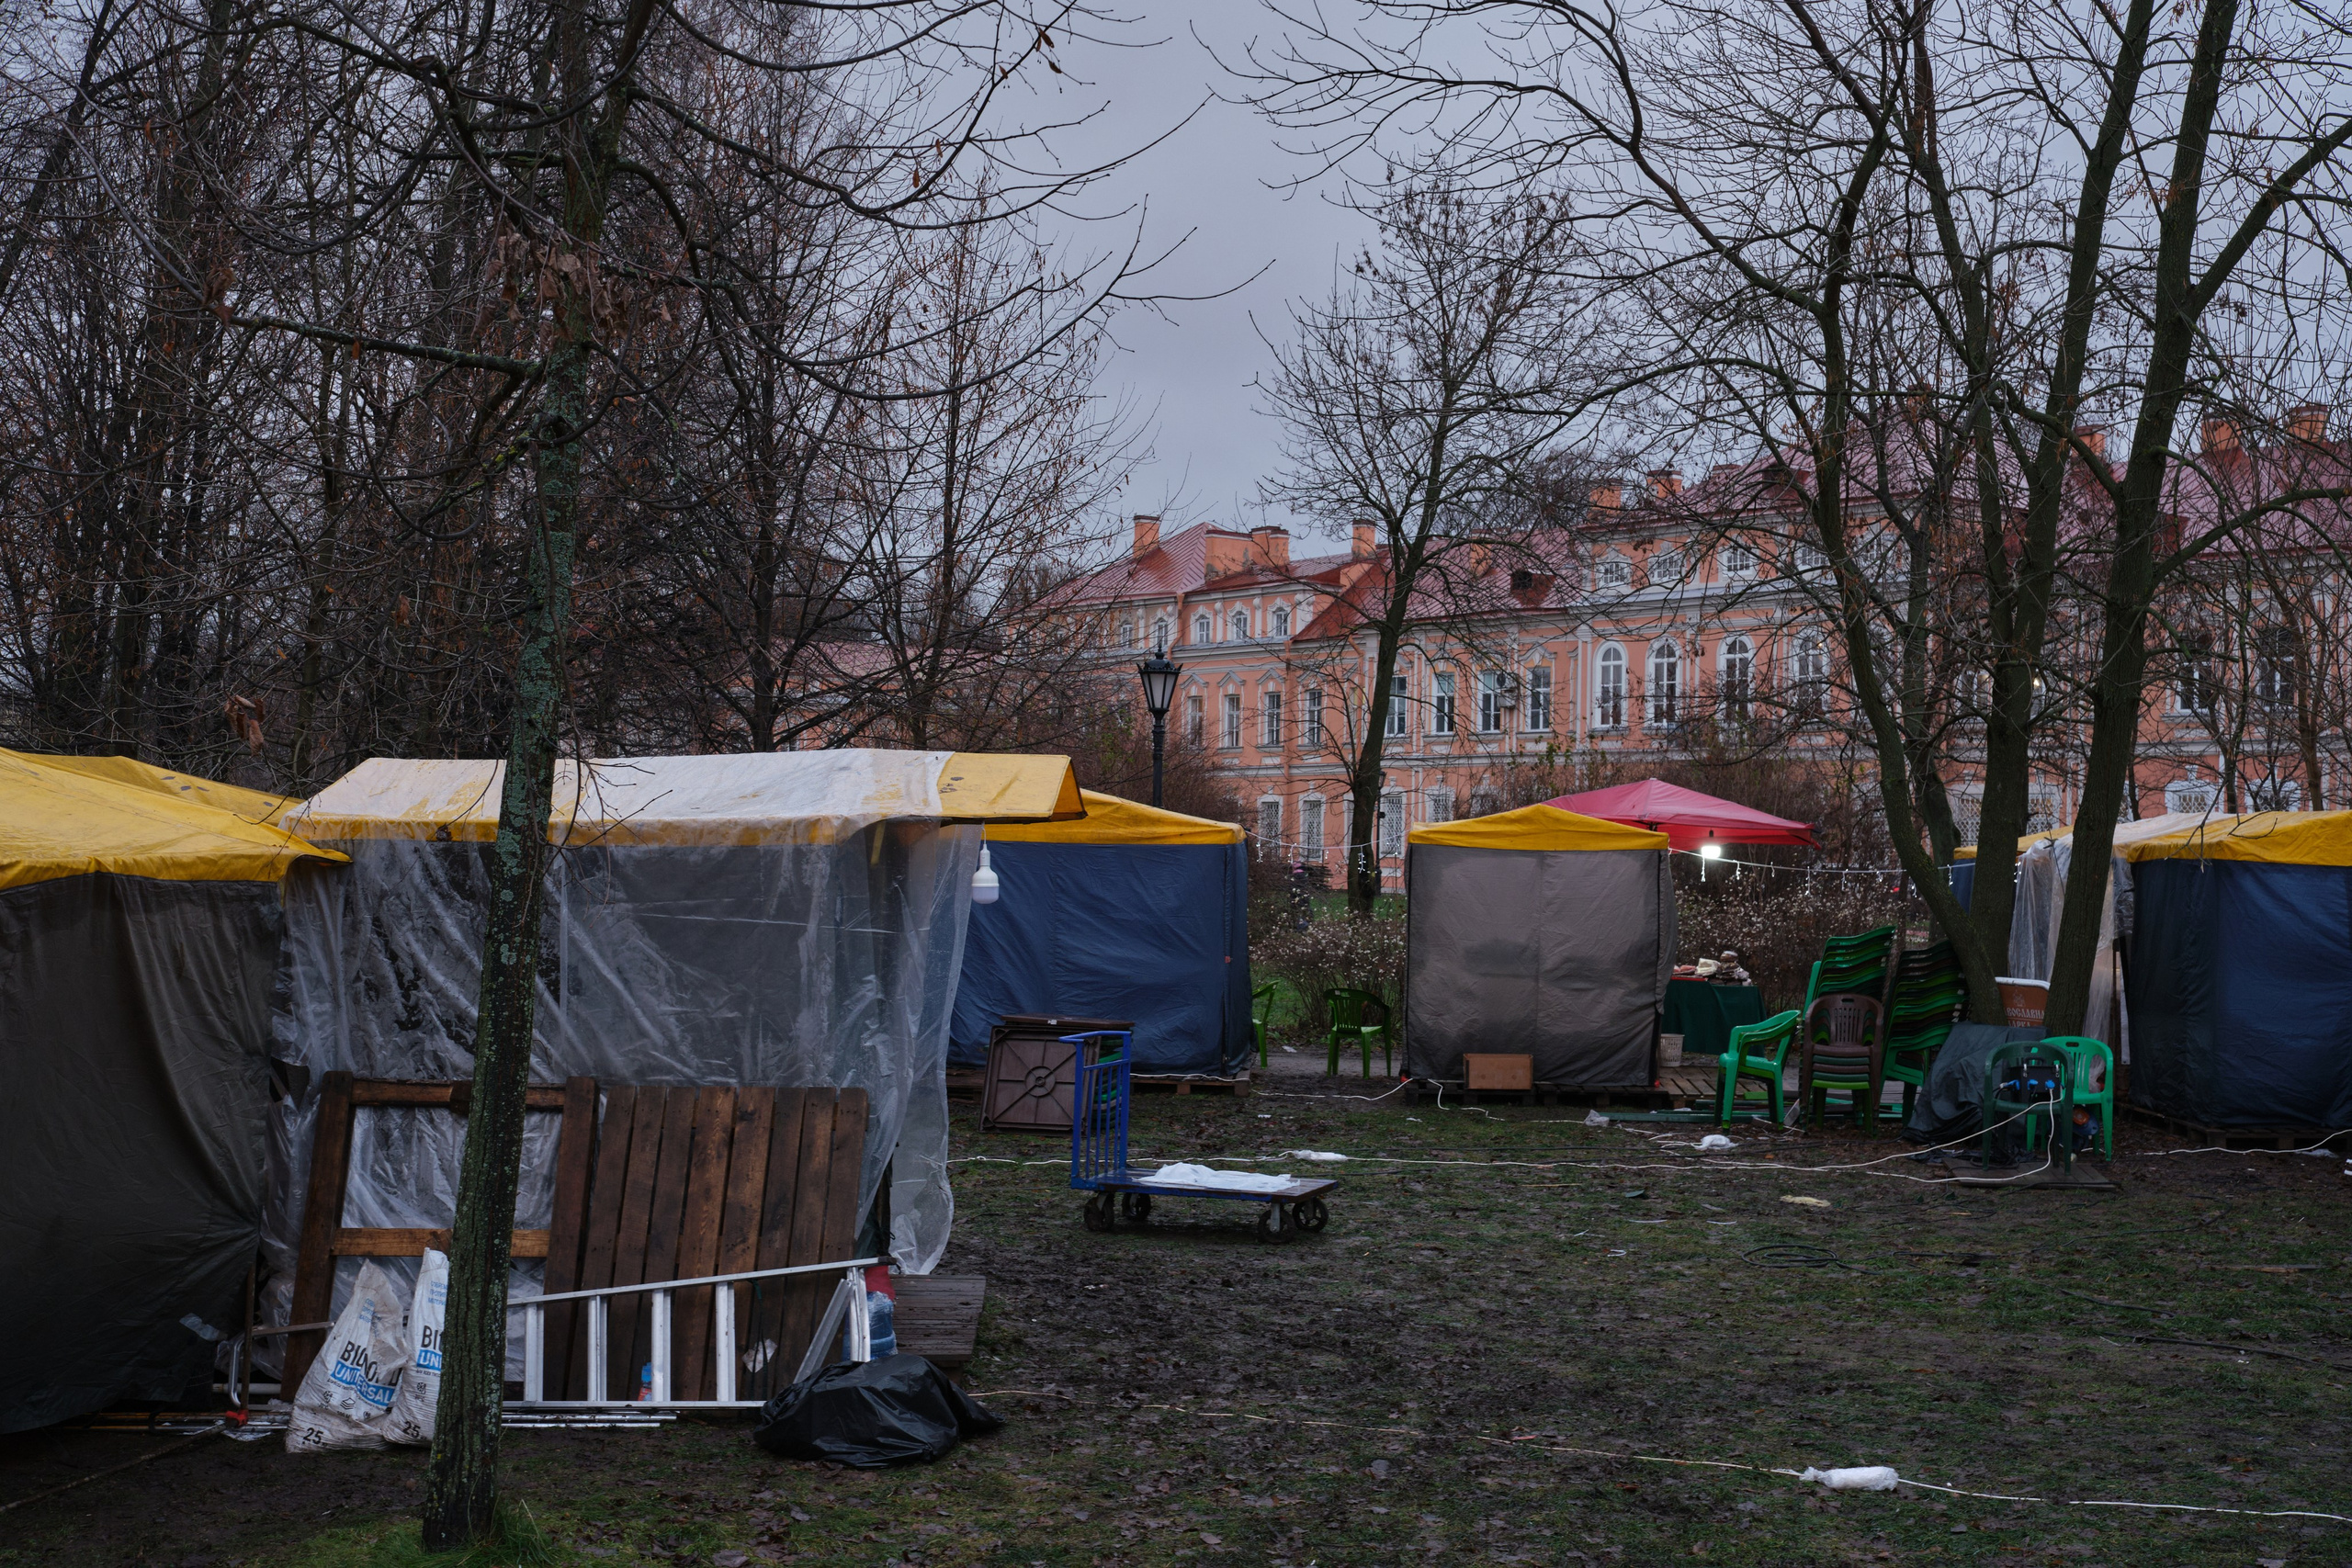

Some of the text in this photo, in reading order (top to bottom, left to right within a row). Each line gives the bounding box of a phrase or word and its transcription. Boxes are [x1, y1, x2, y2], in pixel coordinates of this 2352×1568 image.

[2005, 1007, 2044, 1020] ВОСЛАВНА
[303, 1427, 324, 1444] 25
[402, 1421, 421, 1438] 25
